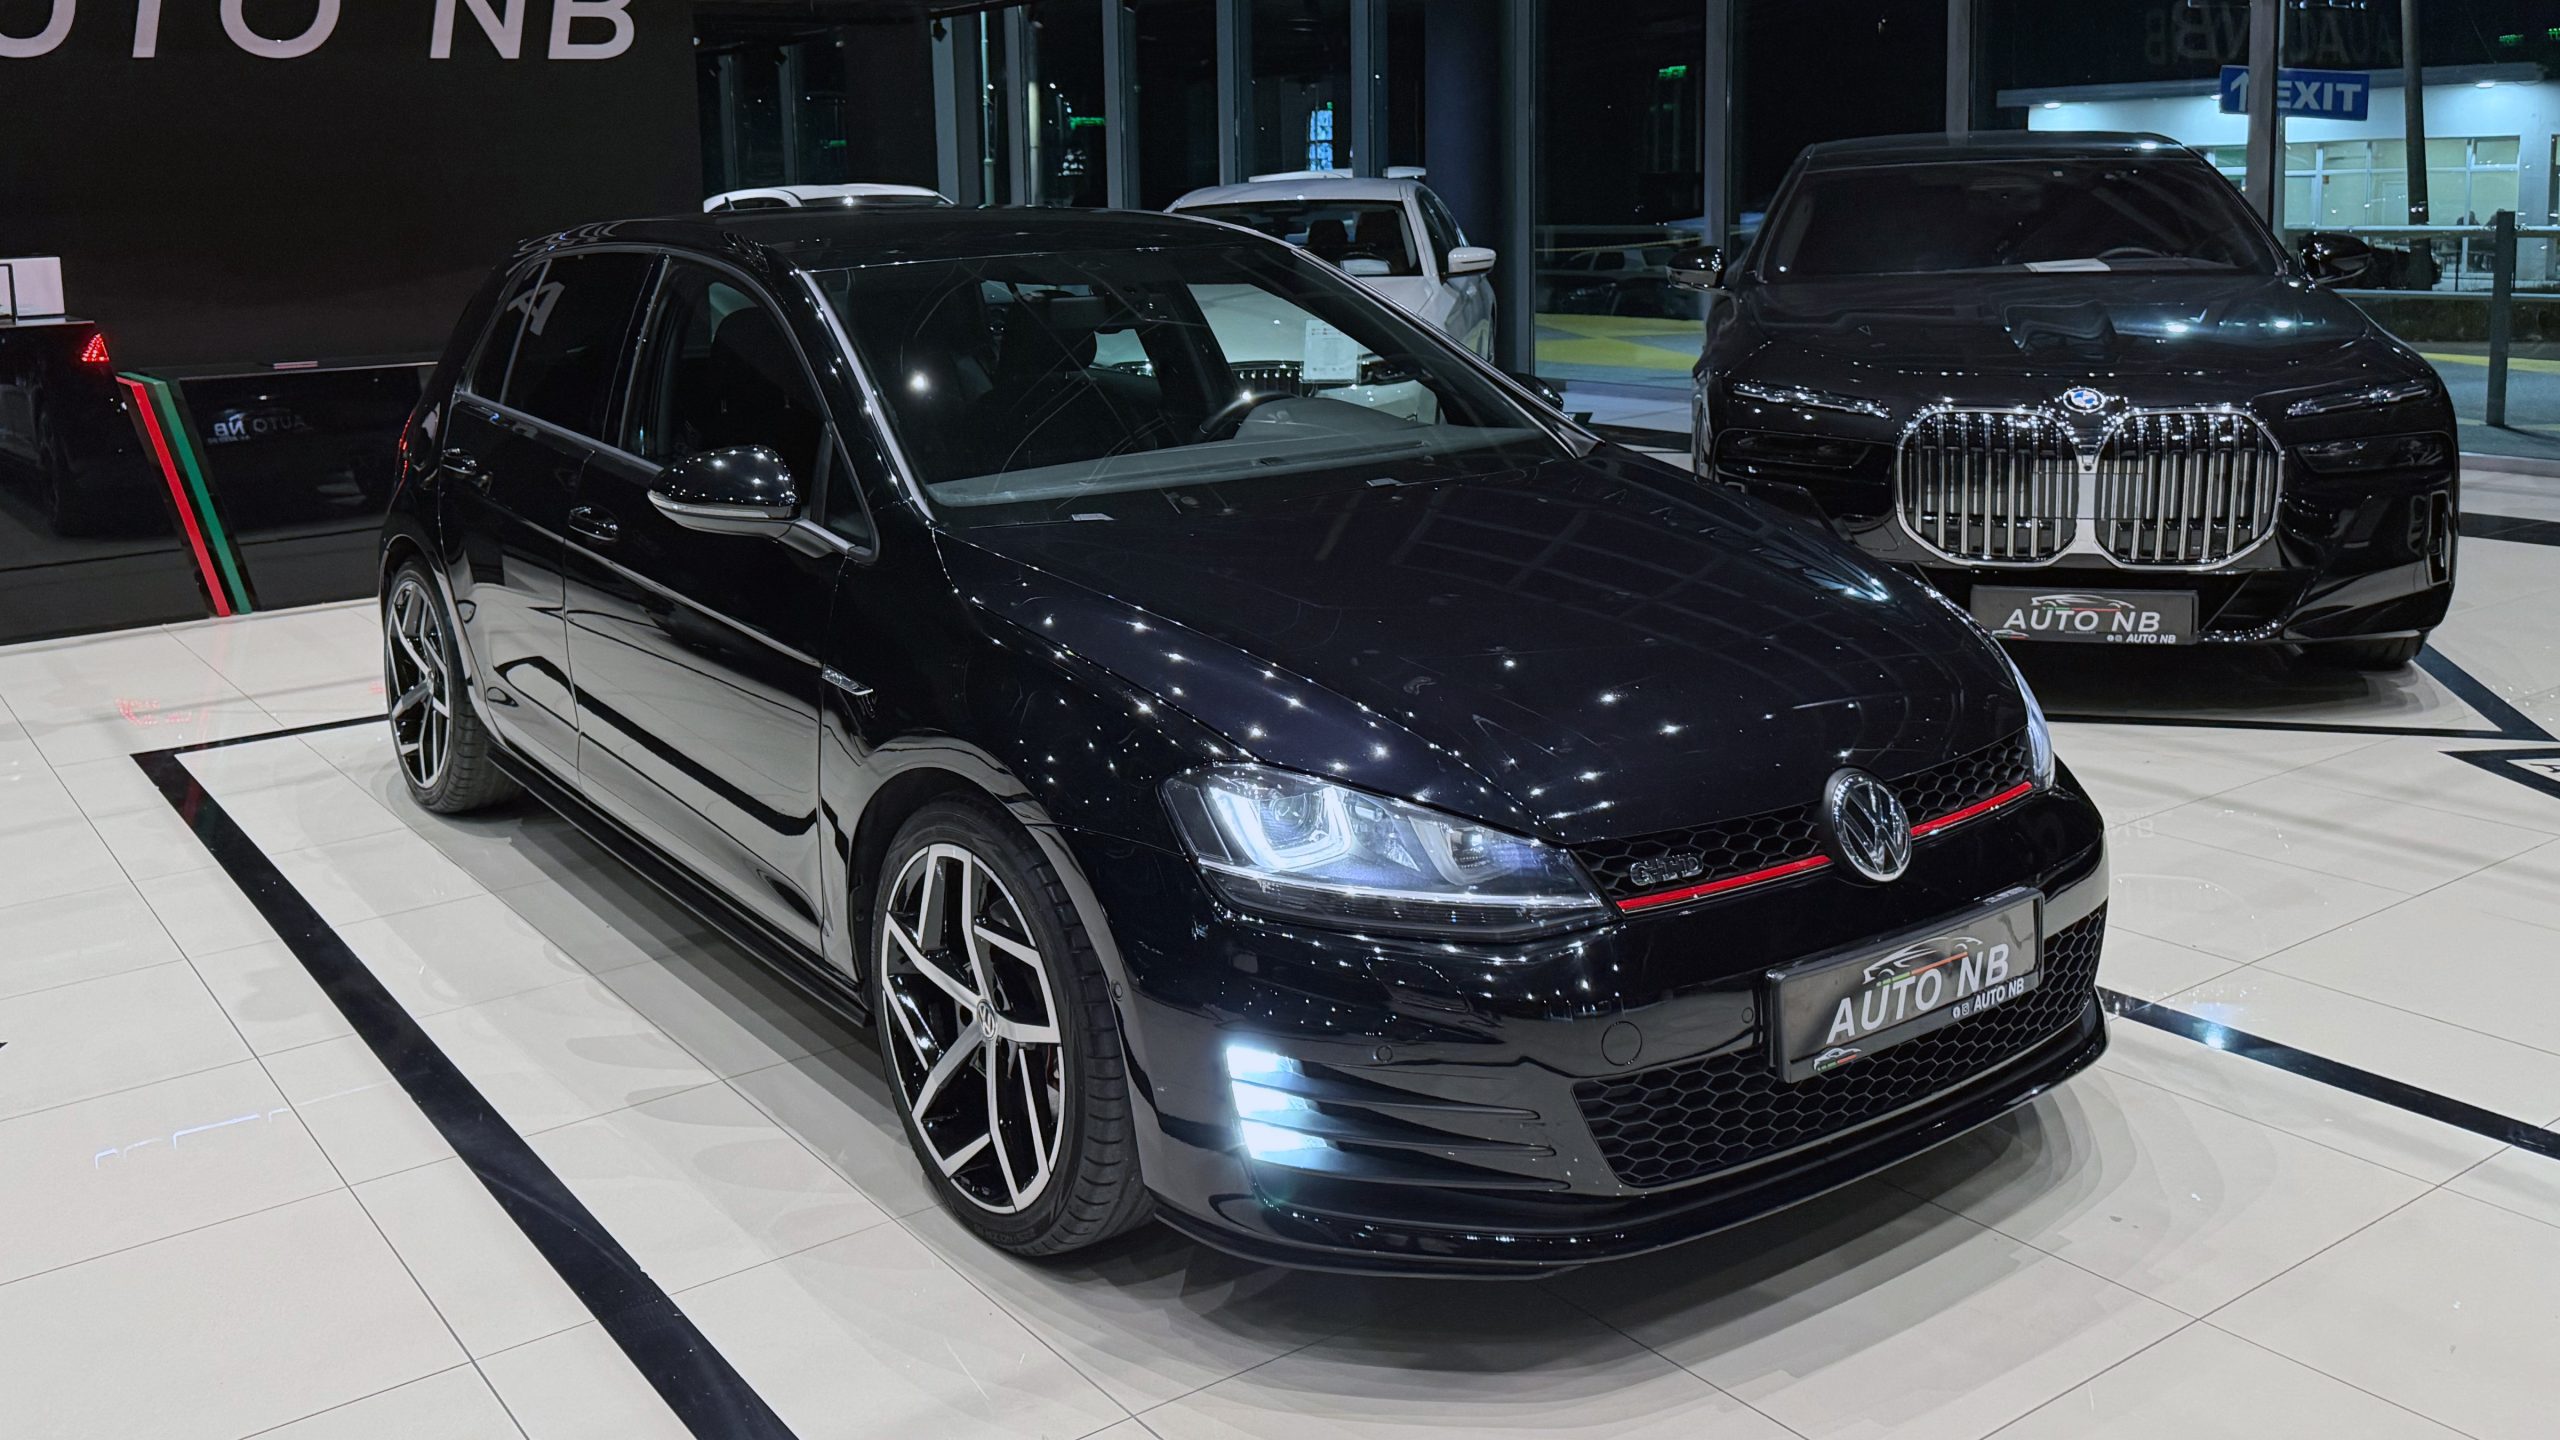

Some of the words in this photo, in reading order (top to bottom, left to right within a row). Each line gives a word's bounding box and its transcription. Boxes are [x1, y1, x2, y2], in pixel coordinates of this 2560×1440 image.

[429, 0, 635, 60] NB
[2277, 80, 2362, 112] EXIT
[2003, 608, 2099, 632] AUTO
[2111, 611, 2161, 633] NB
[2125, 634, 2157, 644] AUTO
[2159, 634, 2177, 644] NB
[1826, 968, 1942, 1044] AUTO
[1956, 943, 2010, 998] NB
[1973, 985, 2006, 1013] AUTO
[2008, 977, 2025, 998] NB
